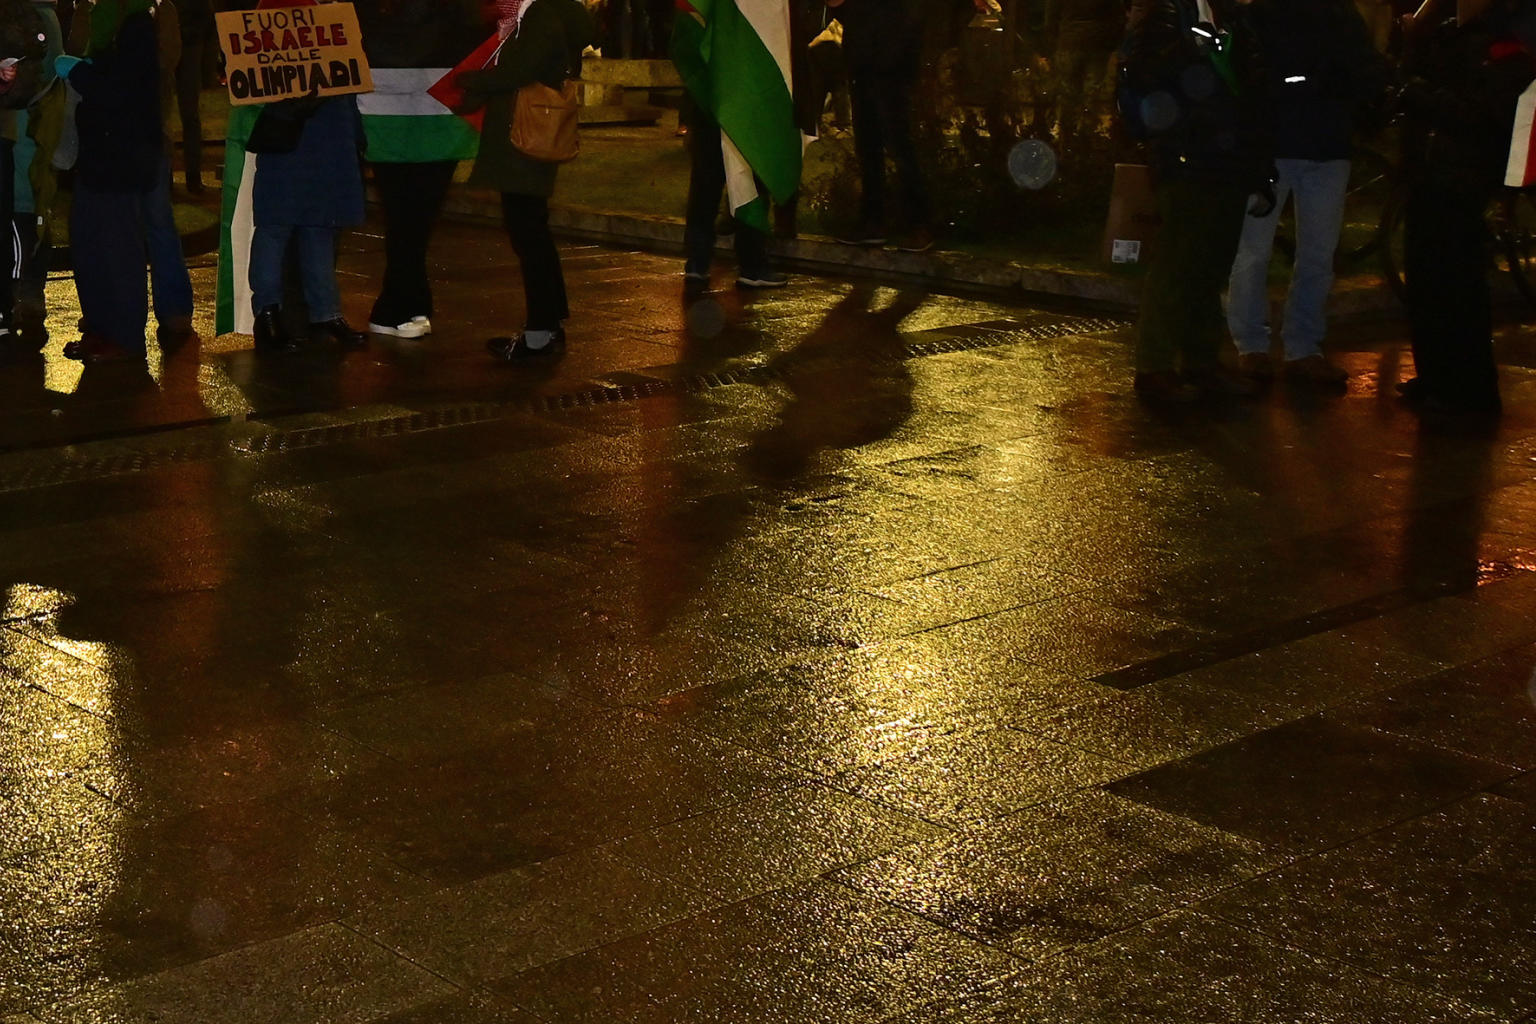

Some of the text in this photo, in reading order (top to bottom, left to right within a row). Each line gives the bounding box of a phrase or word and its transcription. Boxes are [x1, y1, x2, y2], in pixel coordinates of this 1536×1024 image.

[242, 8, 315, 32] FUORI
[229, 23, 348, 55] ISRAELE
[257, 49, 322, 65] DALLE
[229, 58, 362, 99] OLIMPIADI
